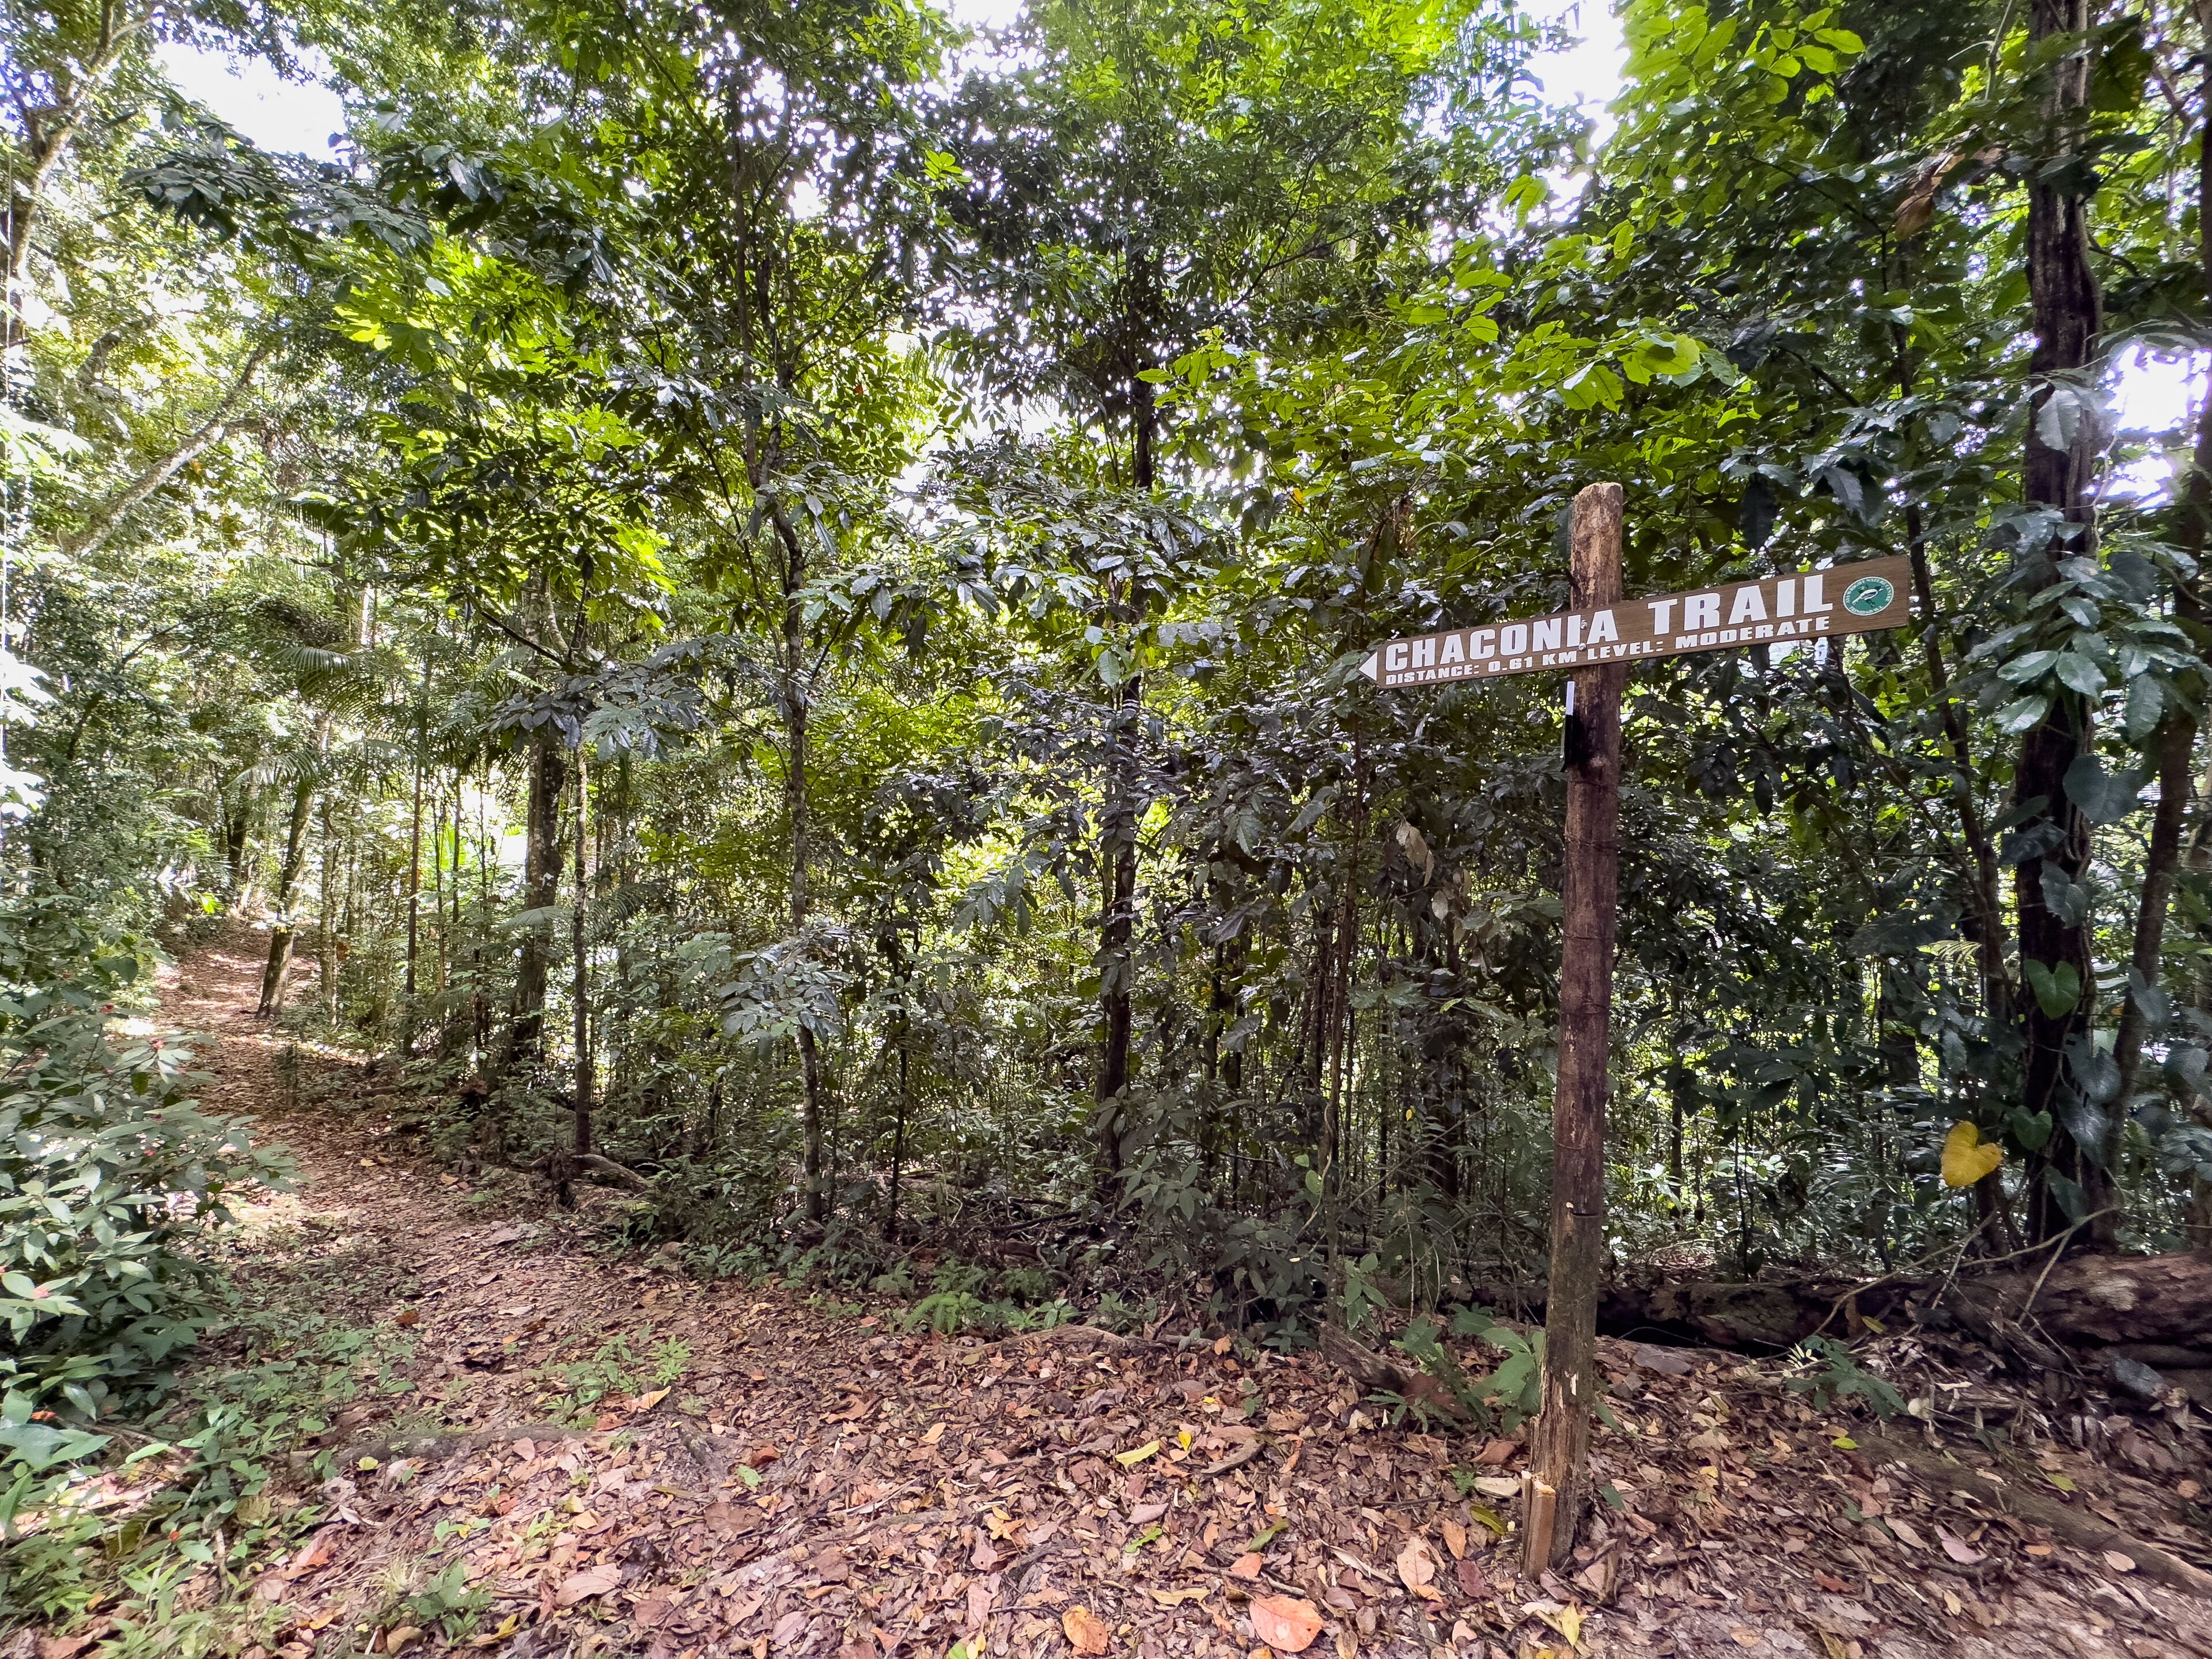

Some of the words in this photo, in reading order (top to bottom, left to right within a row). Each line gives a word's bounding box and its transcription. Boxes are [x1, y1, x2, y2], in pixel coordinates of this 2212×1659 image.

[1385, 609, 1619, 672] CHACONIA
[1647, 574, 1833, 635] TRAIL
[1385, 664, 1480, 685] DISTANCE:
[1488, 656, 1533, 673] 0.61
[1542, 650, 1577, 666] KM
[1587, 641, 1664, 660] LEVEL:
[1675, 616, 1830, 649] MODERATE
